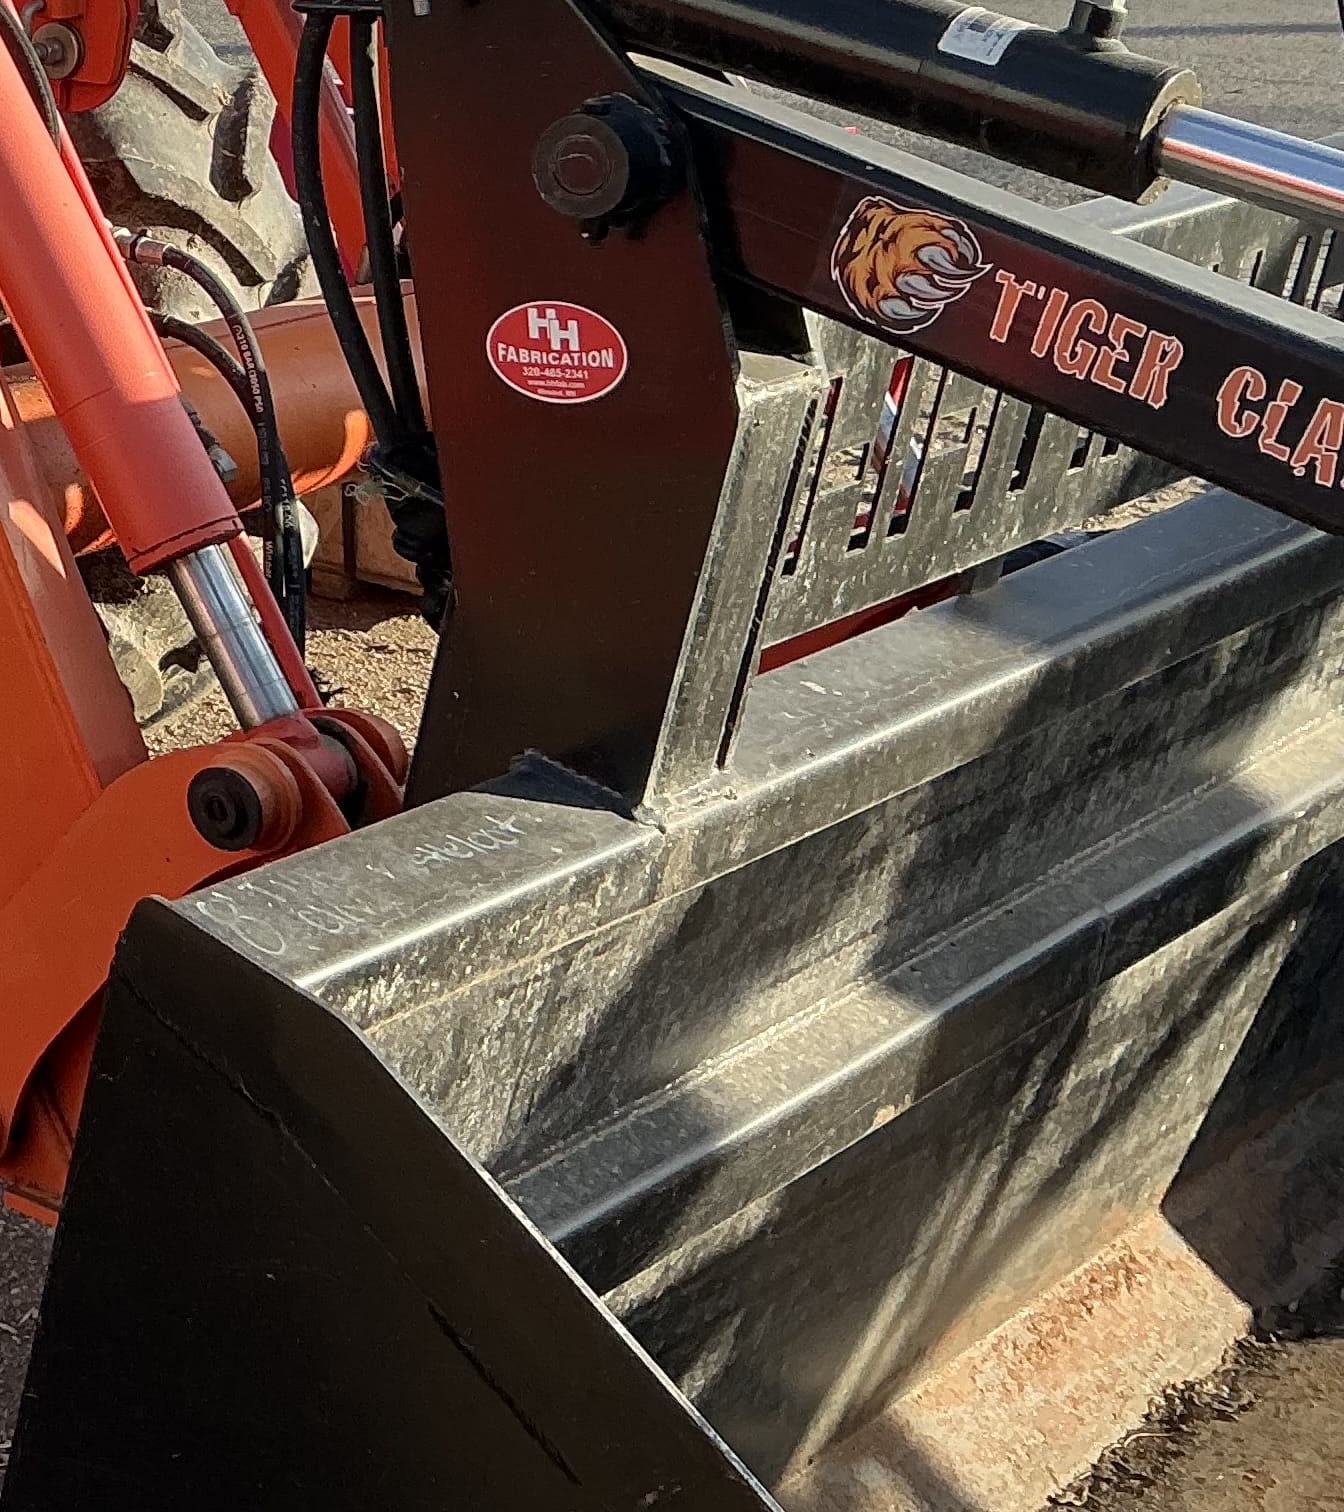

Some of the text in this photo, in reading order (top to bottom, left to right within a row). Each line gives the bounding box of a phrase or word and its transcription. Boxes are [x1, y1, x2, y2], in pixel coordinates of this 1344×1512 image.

[497, 341, 615, 369] FABRICATION
[988, 269, 1344, 490] TIGER CLA
